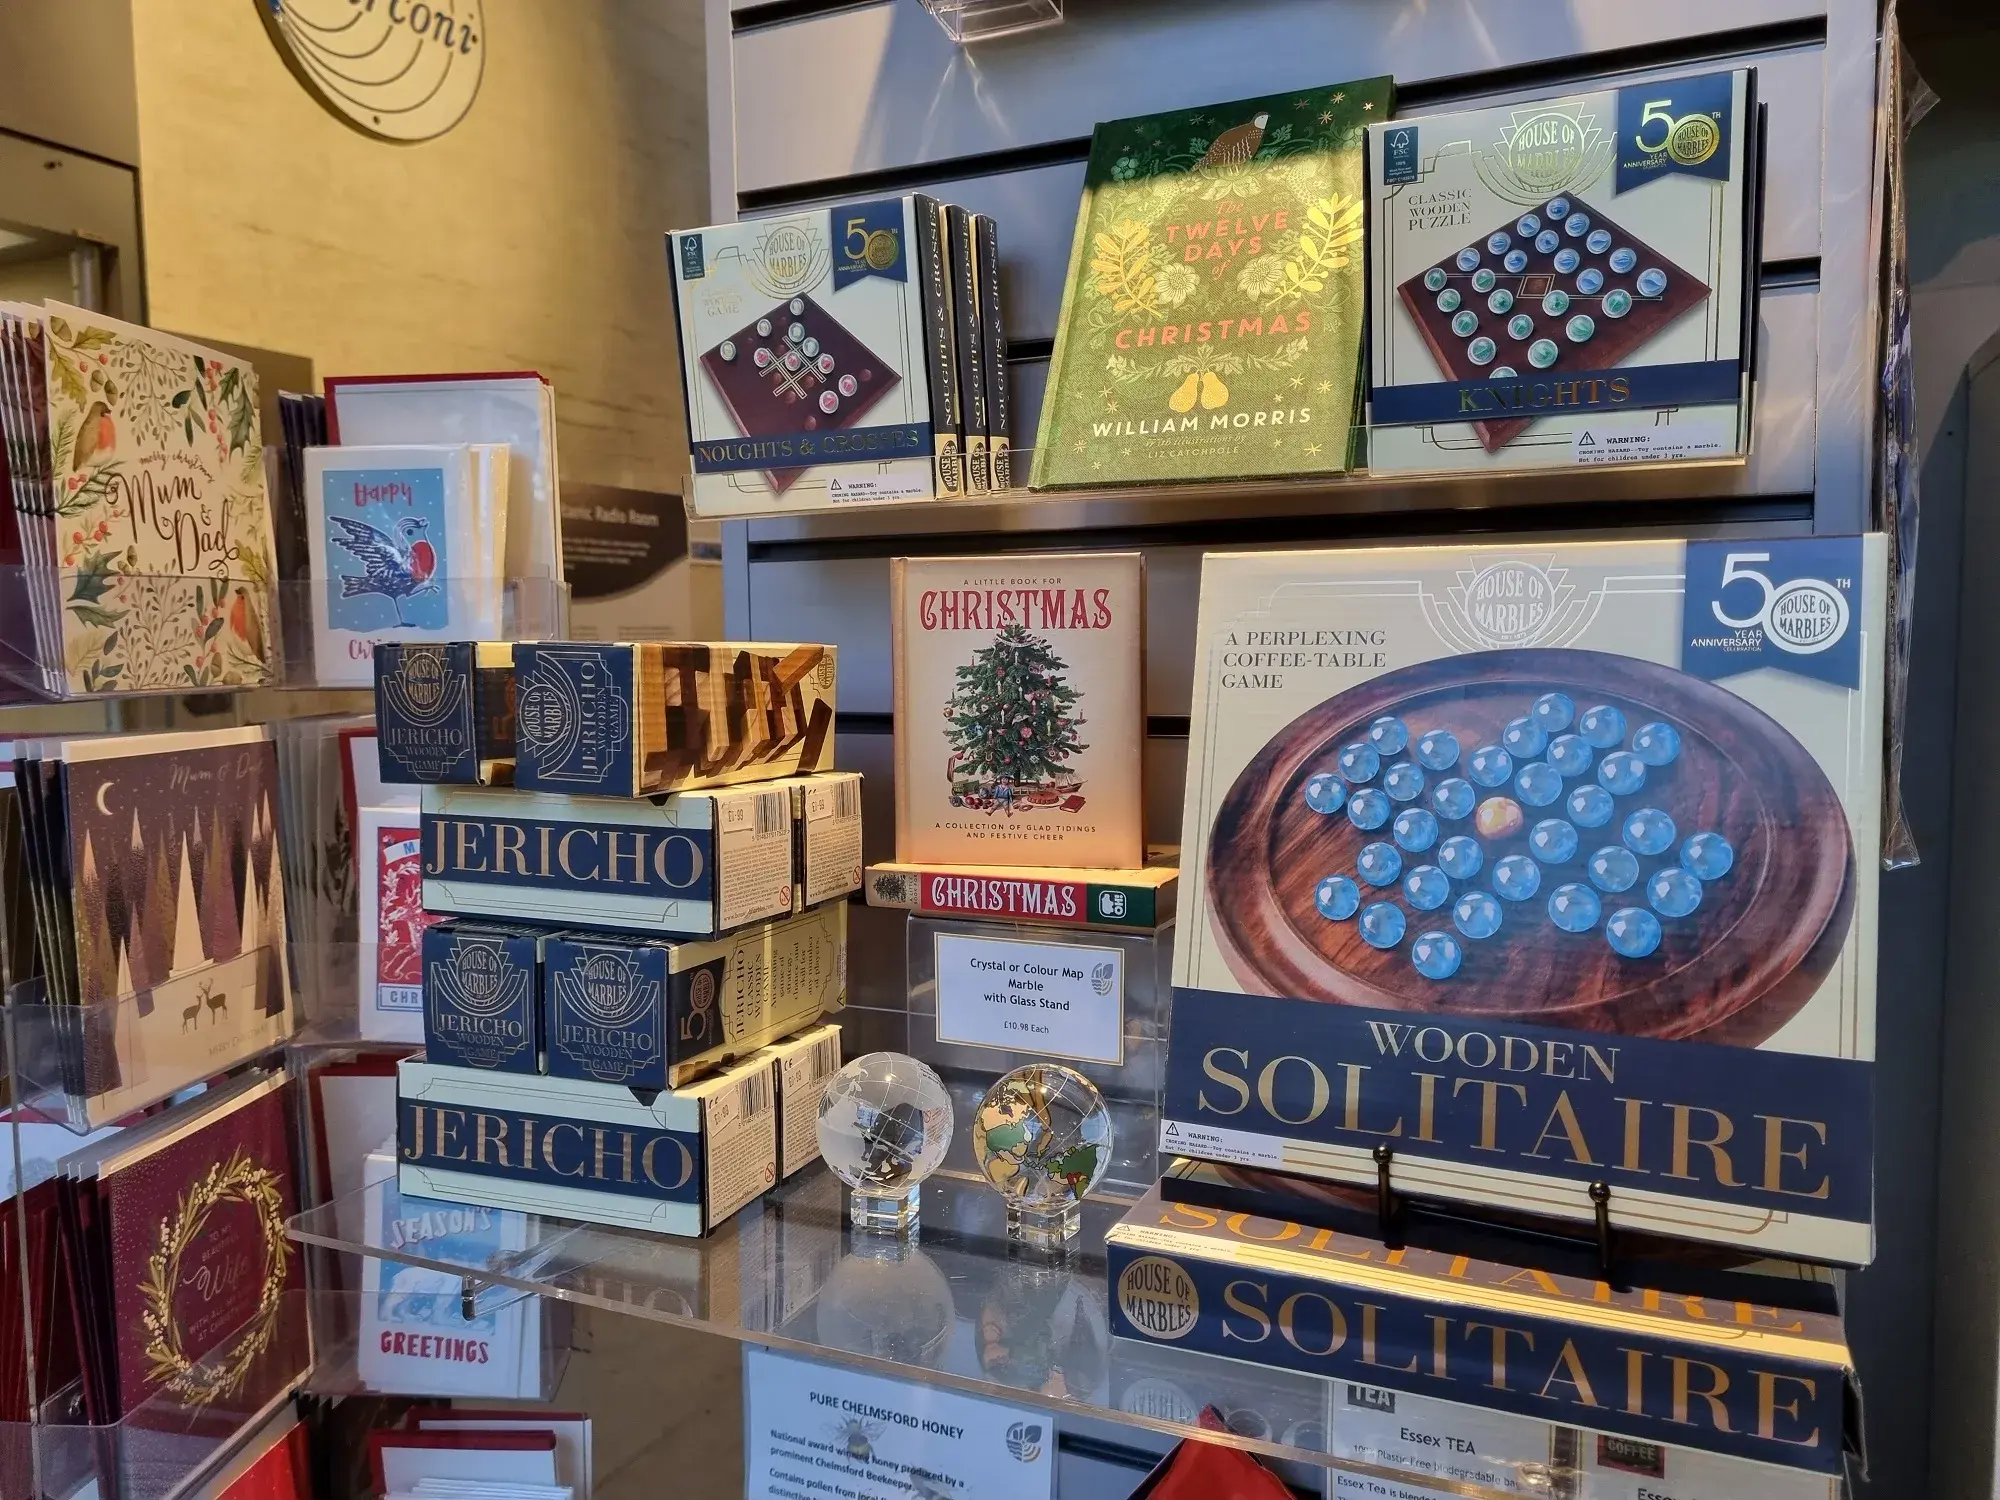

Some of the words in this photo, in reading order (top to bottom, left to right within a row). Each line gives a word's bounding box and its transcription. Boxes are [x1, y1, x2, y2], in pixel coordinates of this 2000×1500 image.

[349, 0, 474, 54] coni
[1519, 121, 1558, 151] HOUSE
[1562, 124, 1574, 144] OF
[1393, 148, 1409, 156] FSC
[1623, 158, 1666, 168] ANNIVERSARY
[1650, 152, 1667, 160] YEAR
[1217, 201, 1244, 215] The
[1408, 188, 1472, 206] CLASSIC
[1408, 212, 1471, 231] PUZZLE
[1410, 202, 1470, 218] WOODEN
[1166, 210, 1289, 243] TWELVE
[769, 232, 794, 256] HOUSE
[796, 238, 806, 251] OF
[1184, 236, 1262, 262] DAYS
[769, 254, 807, 278] MARBLES
[1211, 260, 1232, 280] of
[1114, 311, 1311, 350] CHRISTMAS
[939, 327, 952, 426] NOUGHTS
[970, 334, 982, 428] NOUGHTS
[996, 338, 1006, 430] NOUGHTS
[1458, 376, 1630, 413] KNIGHTS
[1093, 416, 1198, 438] WILLIAM
[1210, 408, 1311, 430] MORRIS
[699, 440, 793, 464] NOUGHTS
[800, 438, 816, 455] &
[824, 430, 919, 454] CROSSES
[1148, 450, 1164, 458] LIZ
[1170, 446, 1239, 458] CATCHPOLE
[1173, 435, 1232, 446] illustrations
[1606, 436, 1650, 444] WARNING:
[1608, 454, 1638, 462] children
[942, 456, 953, 487] HOUSE
[354, 482, 412, 506] Happy
[848, 482, 878, 490] WARNING:
[105, 470, 202, 543] Mum
[172, 498, 240, 583] Dad
[974, 578, 1005, 586] LITTLE
[1477, 570, 1524, 600] HOUSE
[1528, 576, 1544, 599] OF
[1836, 578, 1850, 588] TH
[920, 588, 1112, 630] CHRISTMAS
[1780, 594, 1816, 616] HOUSE
[1820, 600, 1831, 615] OF
[1475, 602, 1544, 634] MARBLES
[1780, 616, 1831, 640] MARBLES
[1225, 632, 1238, 646] A
[1246, 630, 1387, 646] PERPLEXING
[1691, 638, 1762, 647] ANNIVERSARY
[1734, 630, 1762, 638] YEAR
[1223, 652, 1386, 668] COFFEE-TABLE
[1222, 674, 1283, 689] GAME
[408, 683, 440, 705] MARBLES
[528, 691, 542, 702] OF
[525, 704, 542, 738] HOUSE
[543, 691, 562, 738] MARBLES
[581, 661, 598, 774] JERICHO
[598, 687, 606, 750] WOODEN
[610, 694, 618, 738] GAME
[391, 728, 462, 746] JERICHO
[406, 746, 447, 756] WOODEN
[415, 760, 440, 770] GAME
[170, 763, 212, 794] Mum
[1026, 824, 1052, 832] GLAD
[426, 820, 704, 889] JERICHO
[932, 876, 1077, 917] CHRISTMAS
[462, 951, 486, 970] HOUSE
[489, 956, 498, 972] OF
[588, 960, 616, 980] HOUSE
[618, 966, 626, 982] OF
[970, 958, 1006, 972] Crystal
[1009, 964, 1019, 972] or
[1024, 963, 1058, 977] Colour
[1062, 967, 1084, 980] Map
[462, 972, 498, 994] MARBLES
[588, 982, 627, 1006] MARBLES
[736, 950, 745, 1035] JERICHO
[1008, 979, 1044, 991] Marble
[771, 996, 777, 1008] An
[984, 993, 1006, 1004] with
[1010, 996, 1036, 1007] Glass
[1040, 999, 1070, 1011] Stand
[440, 1013, 522, 1038] JERICHO
[562, 1024, 652, 1050] JERICHO
[1004, 1021, 1029, 1032] £10.98
[1031, 1024, 1049, 1034] Each
[456, 1032, 504, 1046] WOODEN
[467, 1048, 496, 1058] GAME
[582, 1044, 632, 1060] WOODEN
[1366, 1020, 1621, 1084] WOODEN
[593, 1060, 624, 1072] GAME
[1198, 1046, 1830, 1201] SOLITAIRE
[404, 1104, 694, 1190] JERICHO
[1188, 1132, 1223, 1143] WARNING:
[390, 1208, 492, 1250] SEASON'S
[183, 1254, 249, 1301] Wife
[1127, 1263, 1172, 1294] HOUSE
[1176, 1274, 1190, 1300] OF
[1126, 1293, 1191, 1332] MARBLES
[380, 1330, 489, 1364] GREETINGS
[1221, 1280, 1820, 1448] SOLITAIRE
[810, 1391, 840, 1408] PURE
[842, 1399, 918, 1429] CHELMSFORD
[922, 1420, 964, 1439] HONEY
[1400, 1427, 1441, 1447] Essex
[1445, 1436, 1476, 1455] TEA
[1608, 1440, 1656, 1460] COFFEE
[770, 1429, 806, 1446] National
[807, 1439, 834, 1453] award
[872, 1453, 899, 1472] honey
[901, 1463, 943, 1482] produced
[945, 1475, 957, 1488] by
[770, 1447, 814, 1465] prominent
[816, 1455, 864, 1479] Chelmsford
[866, 1471, 914, 1493] Beekeeper.
[769, 1468, 805, 1487] Contains
[806, 1479, 833, 1494] pollen
[835, 1485, 856, 1498] from
[1434, 1462, 1500, 1485] biodegradable
[1337, 1476, 1365, 1490] Essex
[1367, 1482, 1386, 1495] Tea
[1389, 1487, 1397, 1497] is
